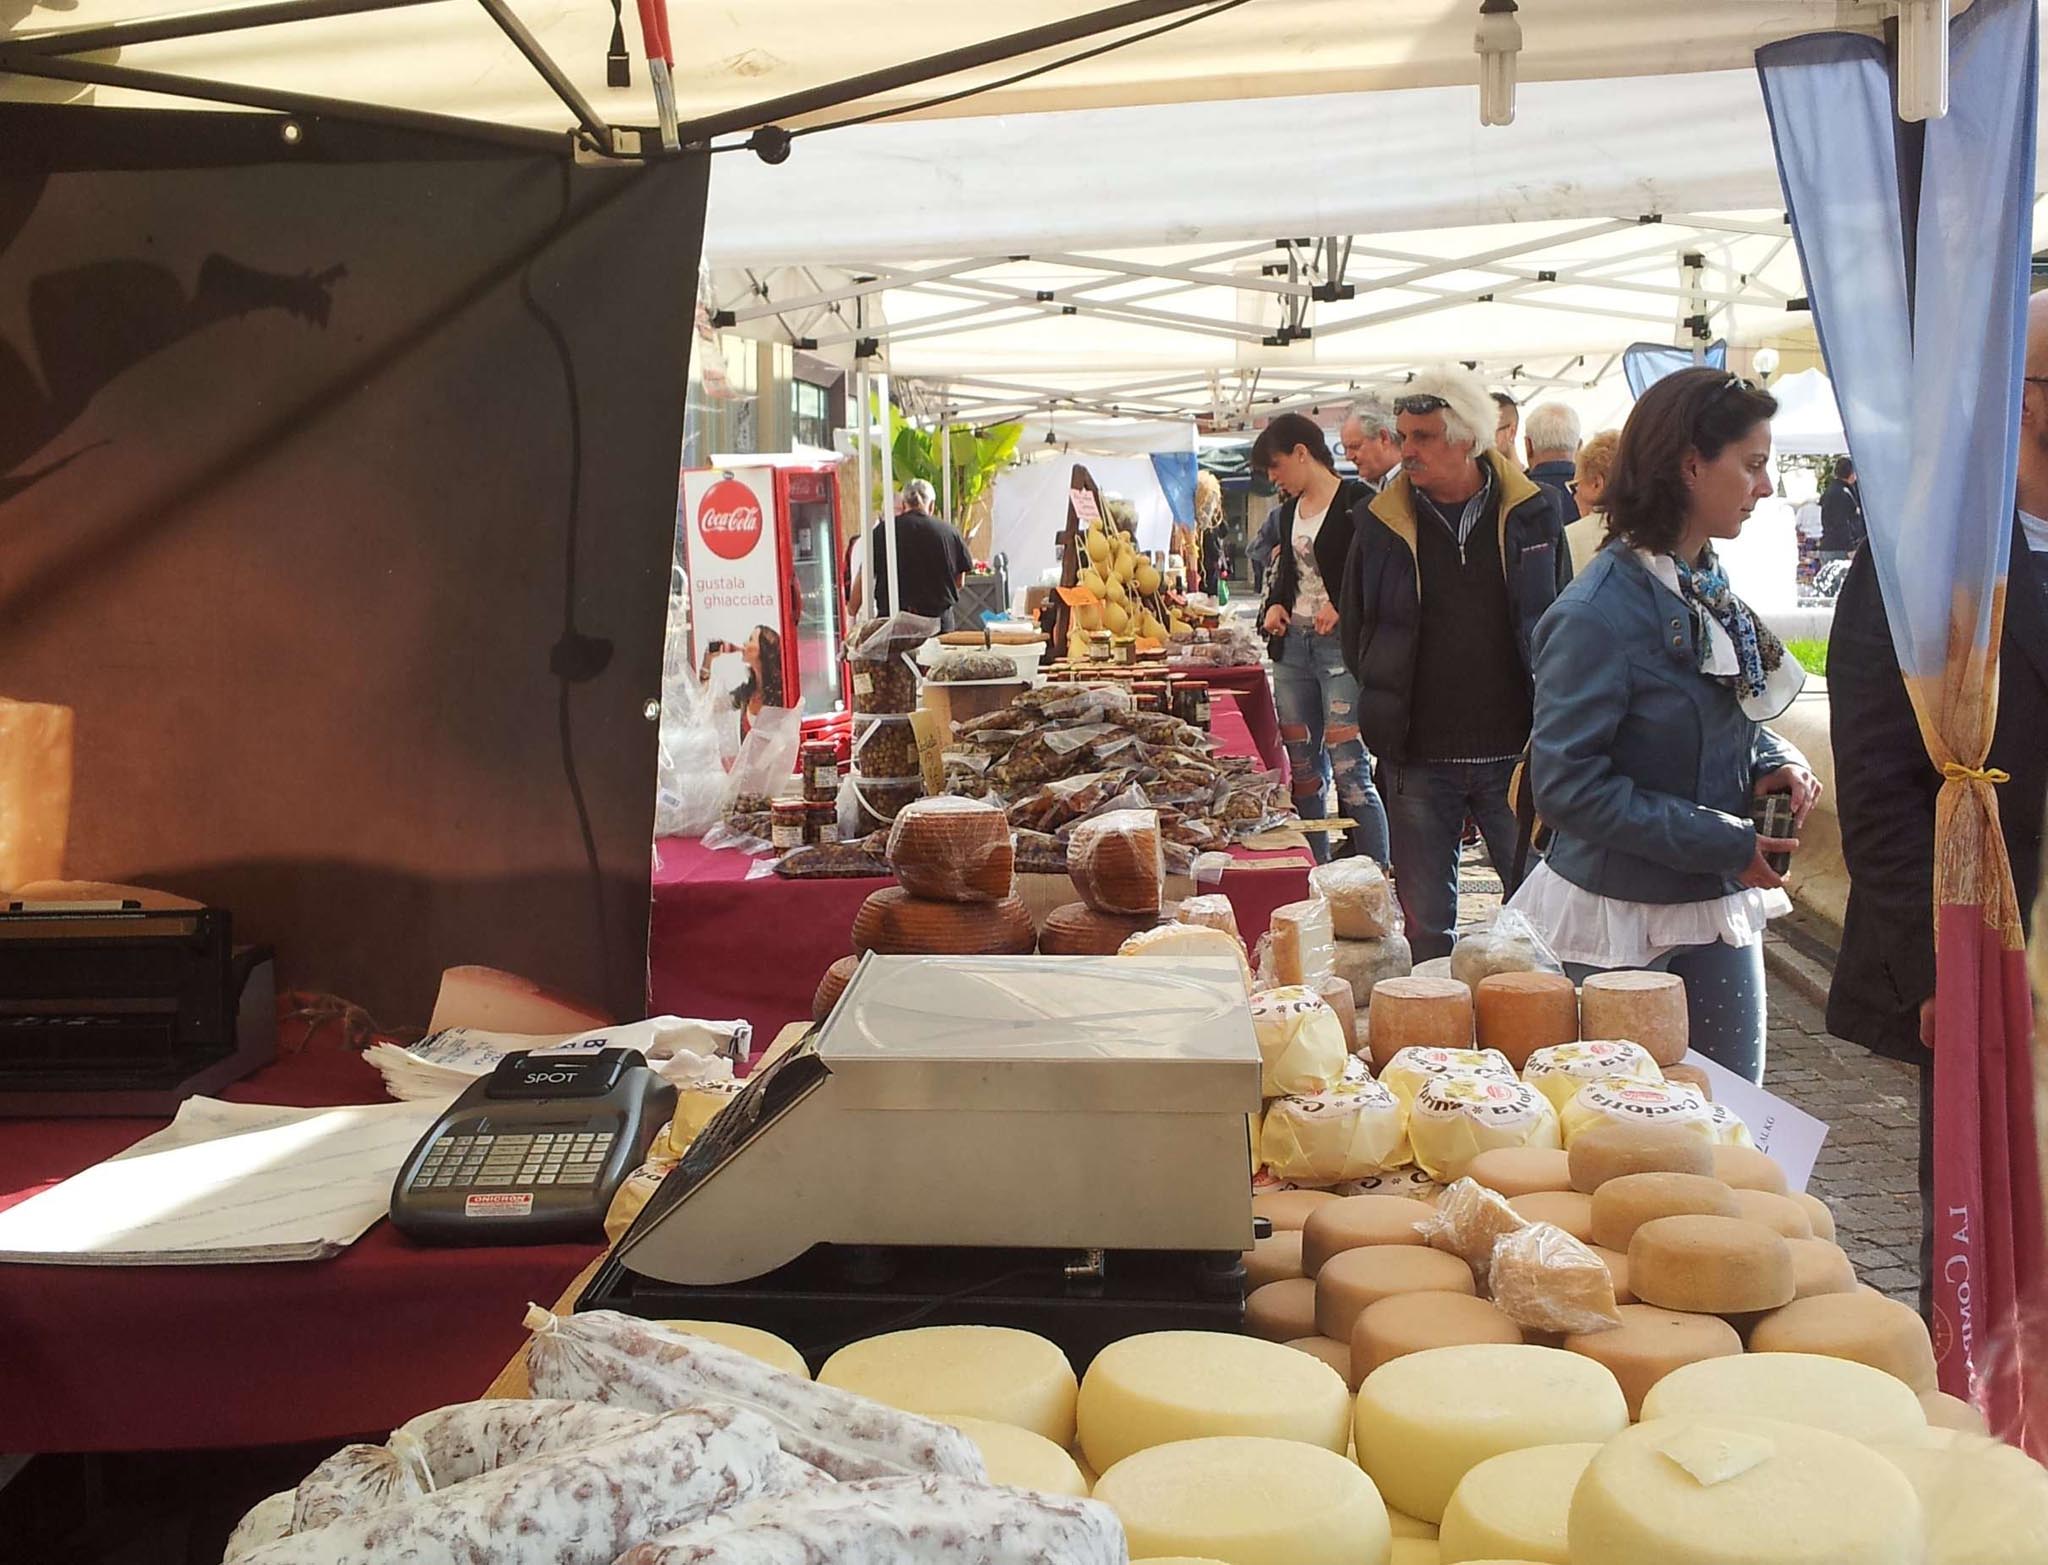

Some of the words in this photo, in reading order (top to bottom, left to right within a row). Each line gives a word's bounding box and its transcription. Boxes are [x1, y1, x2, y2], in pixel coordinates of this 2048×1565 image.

[696, 576, 745, 592] gustala
[703, 593, 774, 609] ghiacciata
[523, 1072, 579, 1084] SPOT
[1591, 1093, 1699, 1118] Caciotta
